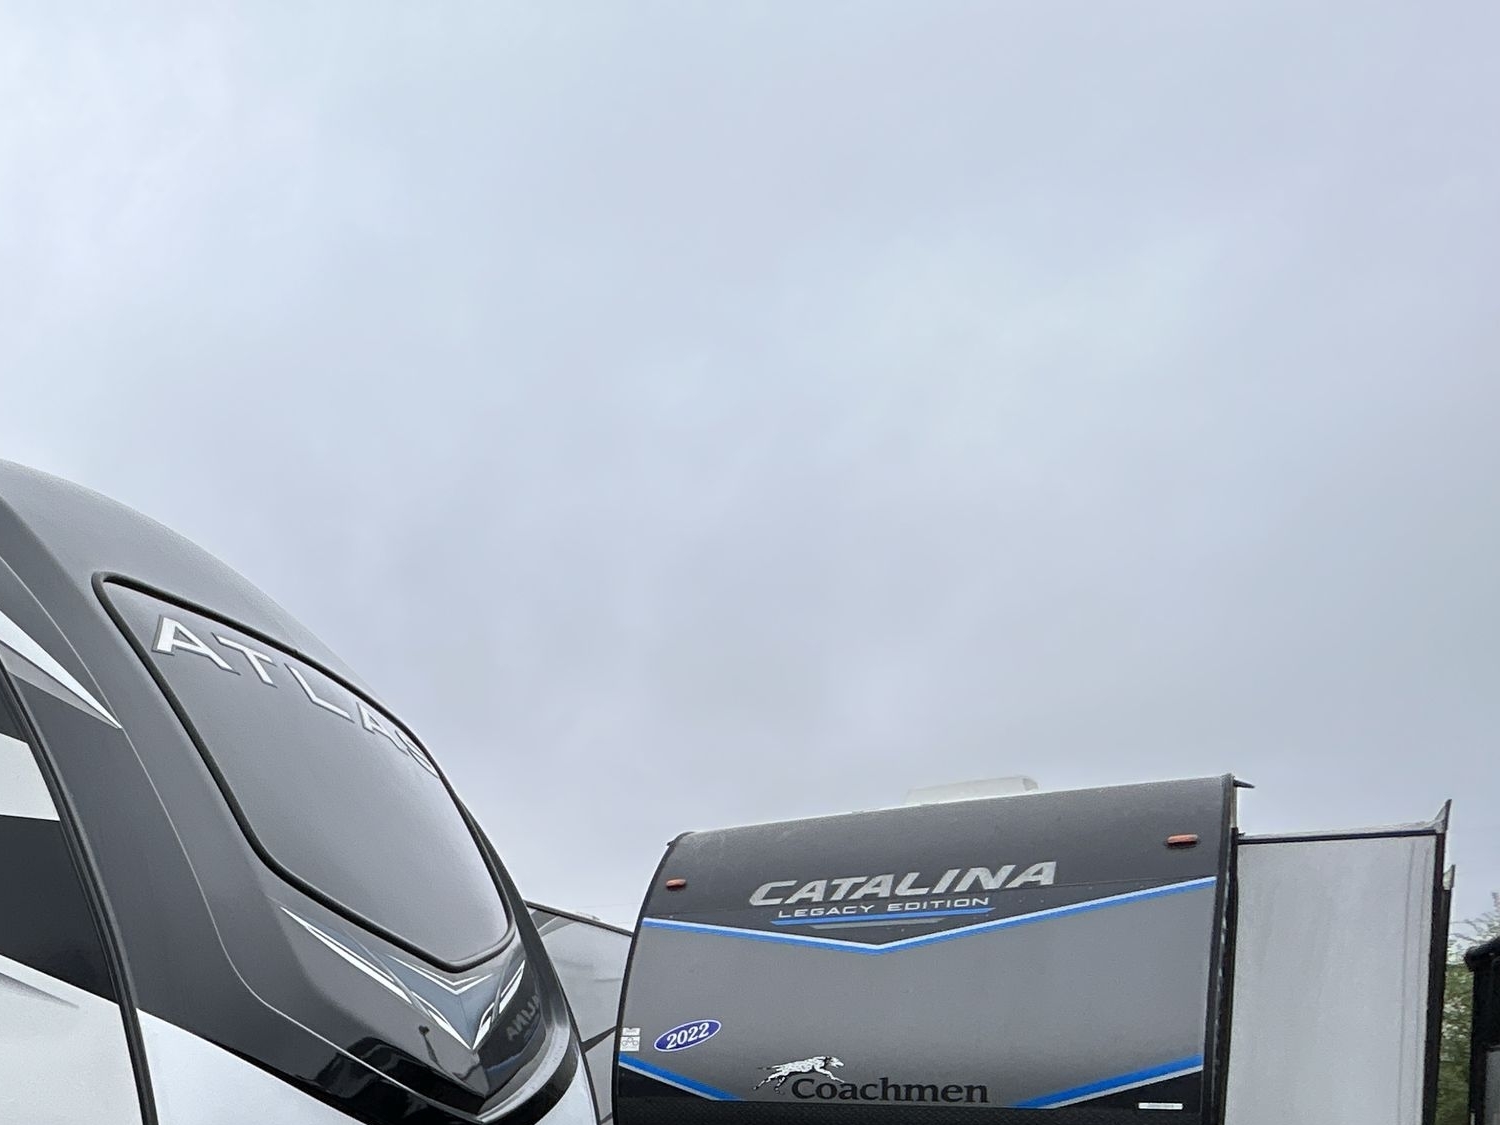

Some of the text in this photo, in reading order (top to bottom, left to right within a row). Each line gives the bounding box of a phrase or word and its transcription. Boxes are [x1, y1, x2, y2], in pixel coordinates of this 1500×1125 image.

[749, 861, 1058, 906] CATALINA
[778, 897, 990, 919] LEGACY EDITION
[666, 1022, 710, 1049] 2022
[791, 1077, 989, 1103] Coachmen
